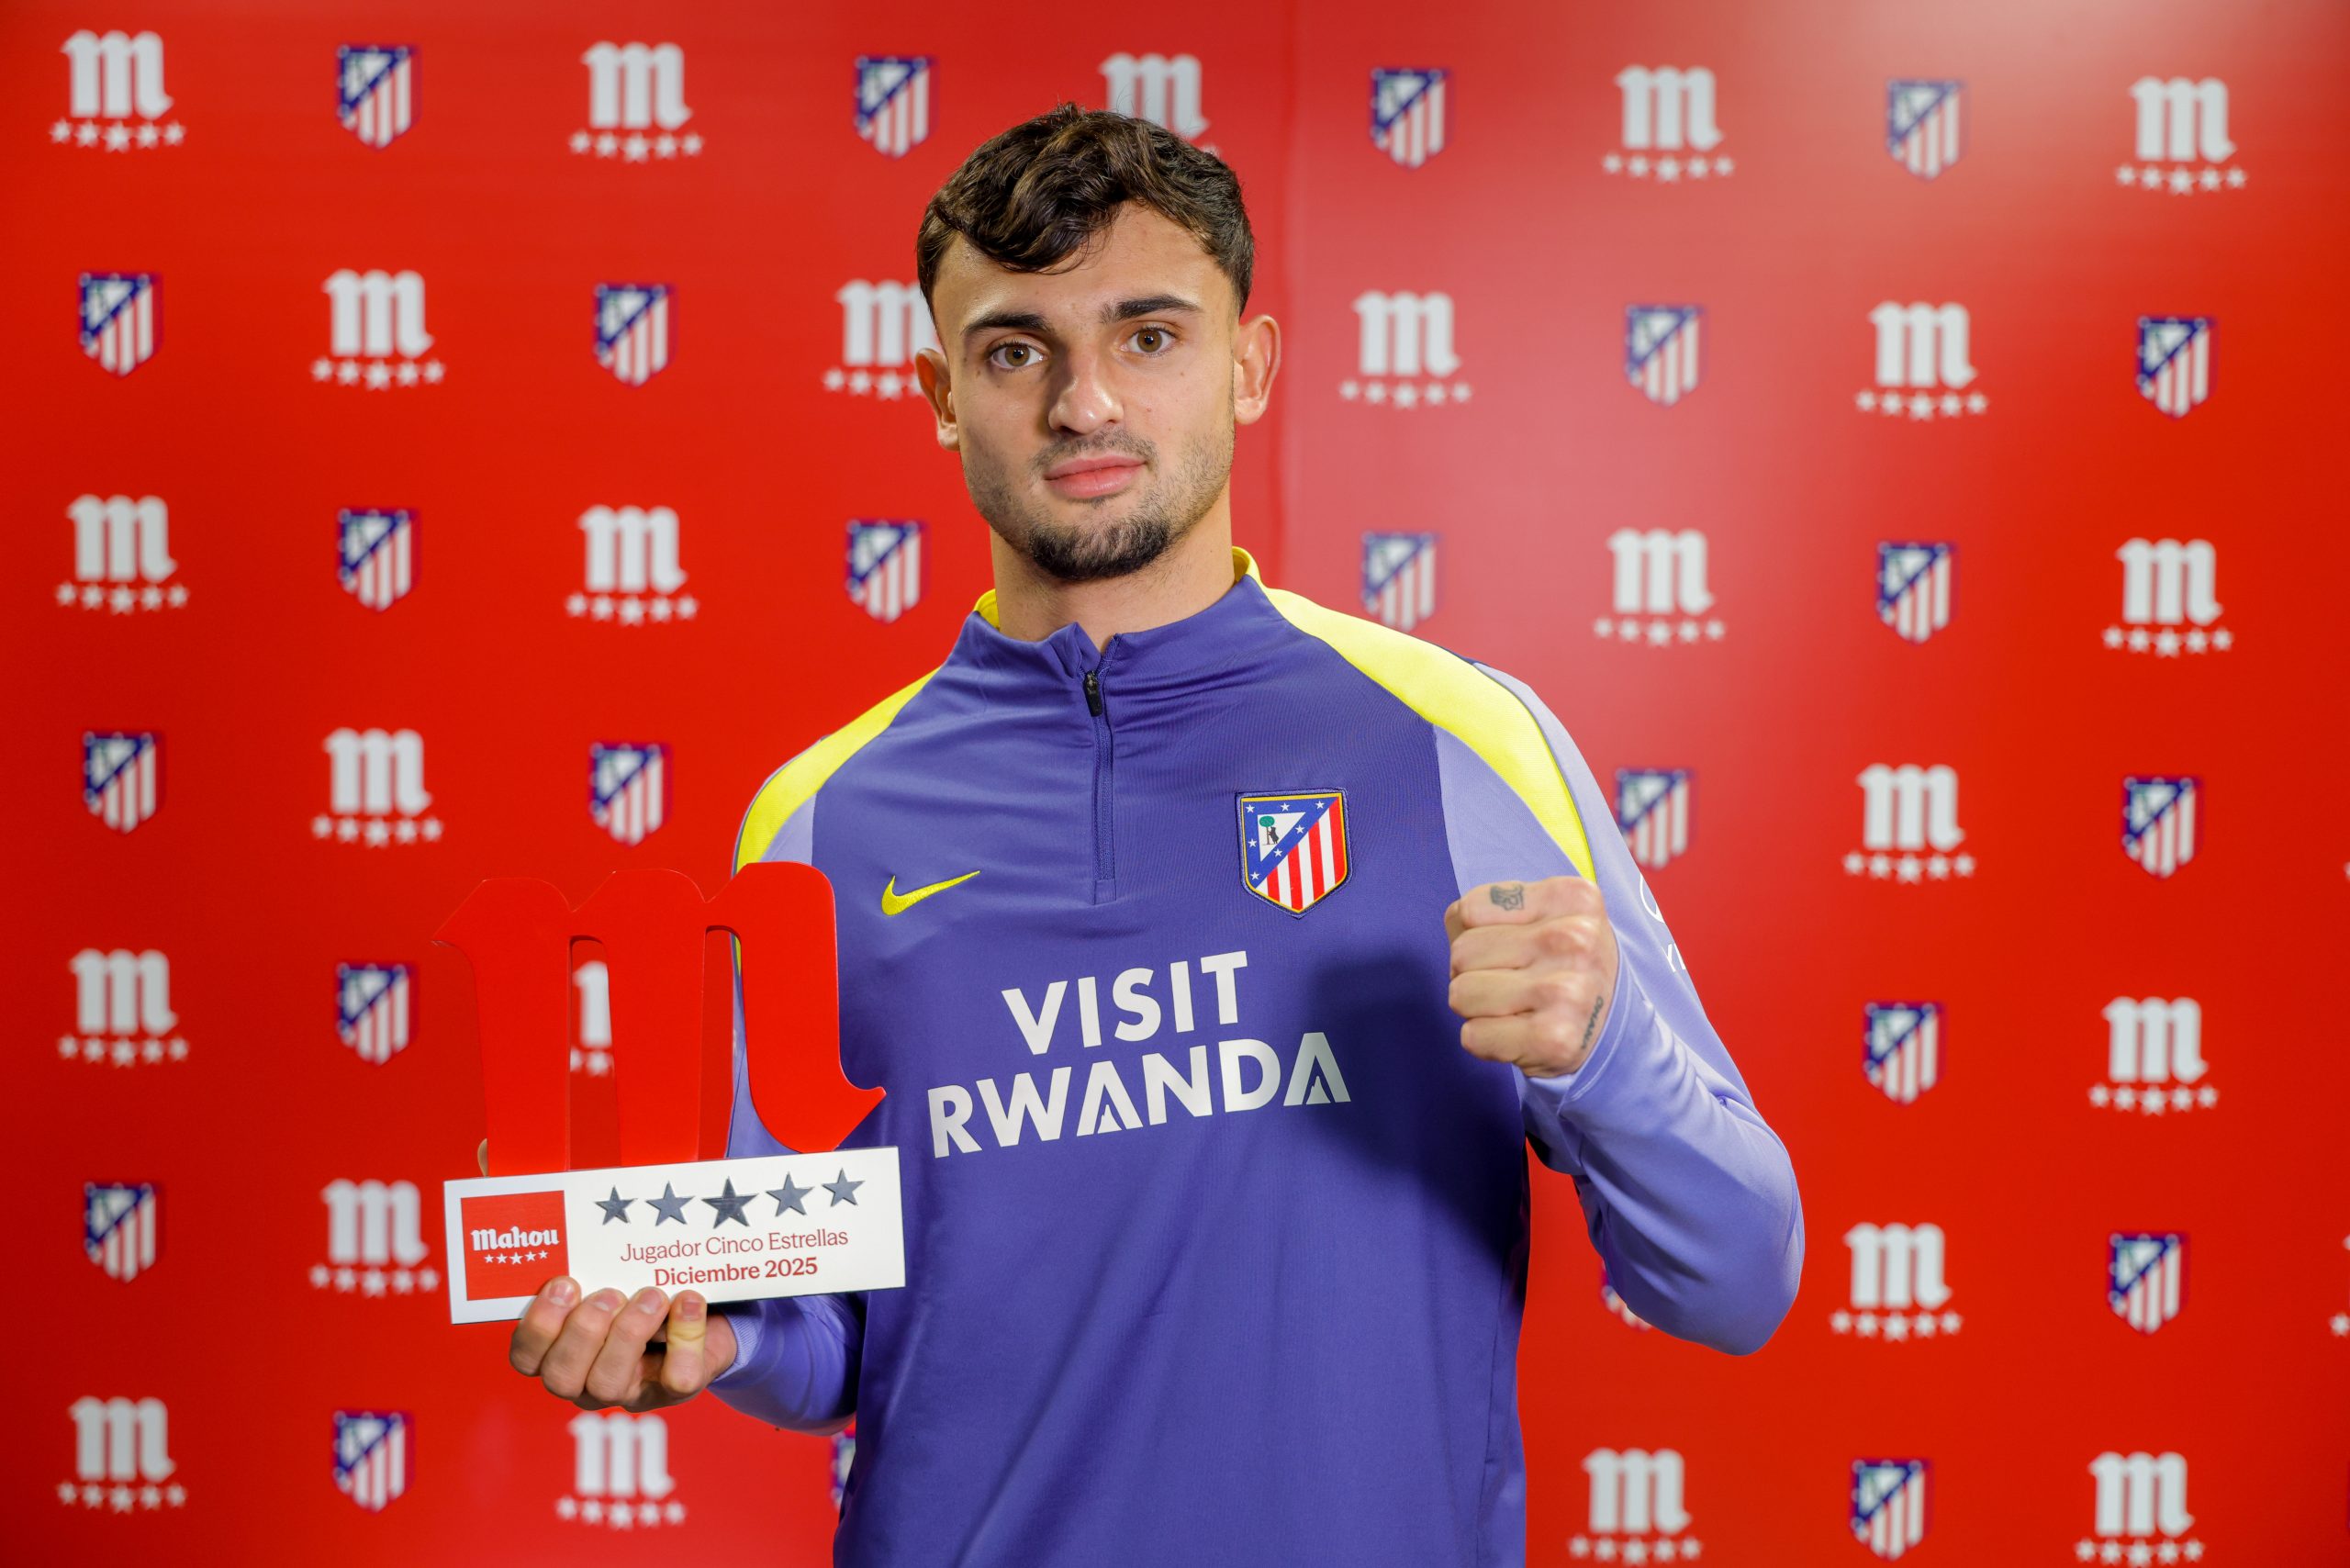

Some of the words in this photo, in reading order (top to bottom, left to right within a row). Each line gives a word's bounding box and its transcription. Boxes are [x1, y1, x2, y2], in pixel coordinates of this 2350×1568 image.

[1002, 951, 1248, 1056] VISIT
[927, 1032, 1351, 1159] RWANDA
[620, 1239, 701, 1264] Jugador
[705, 1236, 764, 1255] Cinco
[768, 1228, 849, 1251] Estrellas
[654, 1263, 760, 1287] Diciembre
[764, 1257, 819, 1279] 2025
